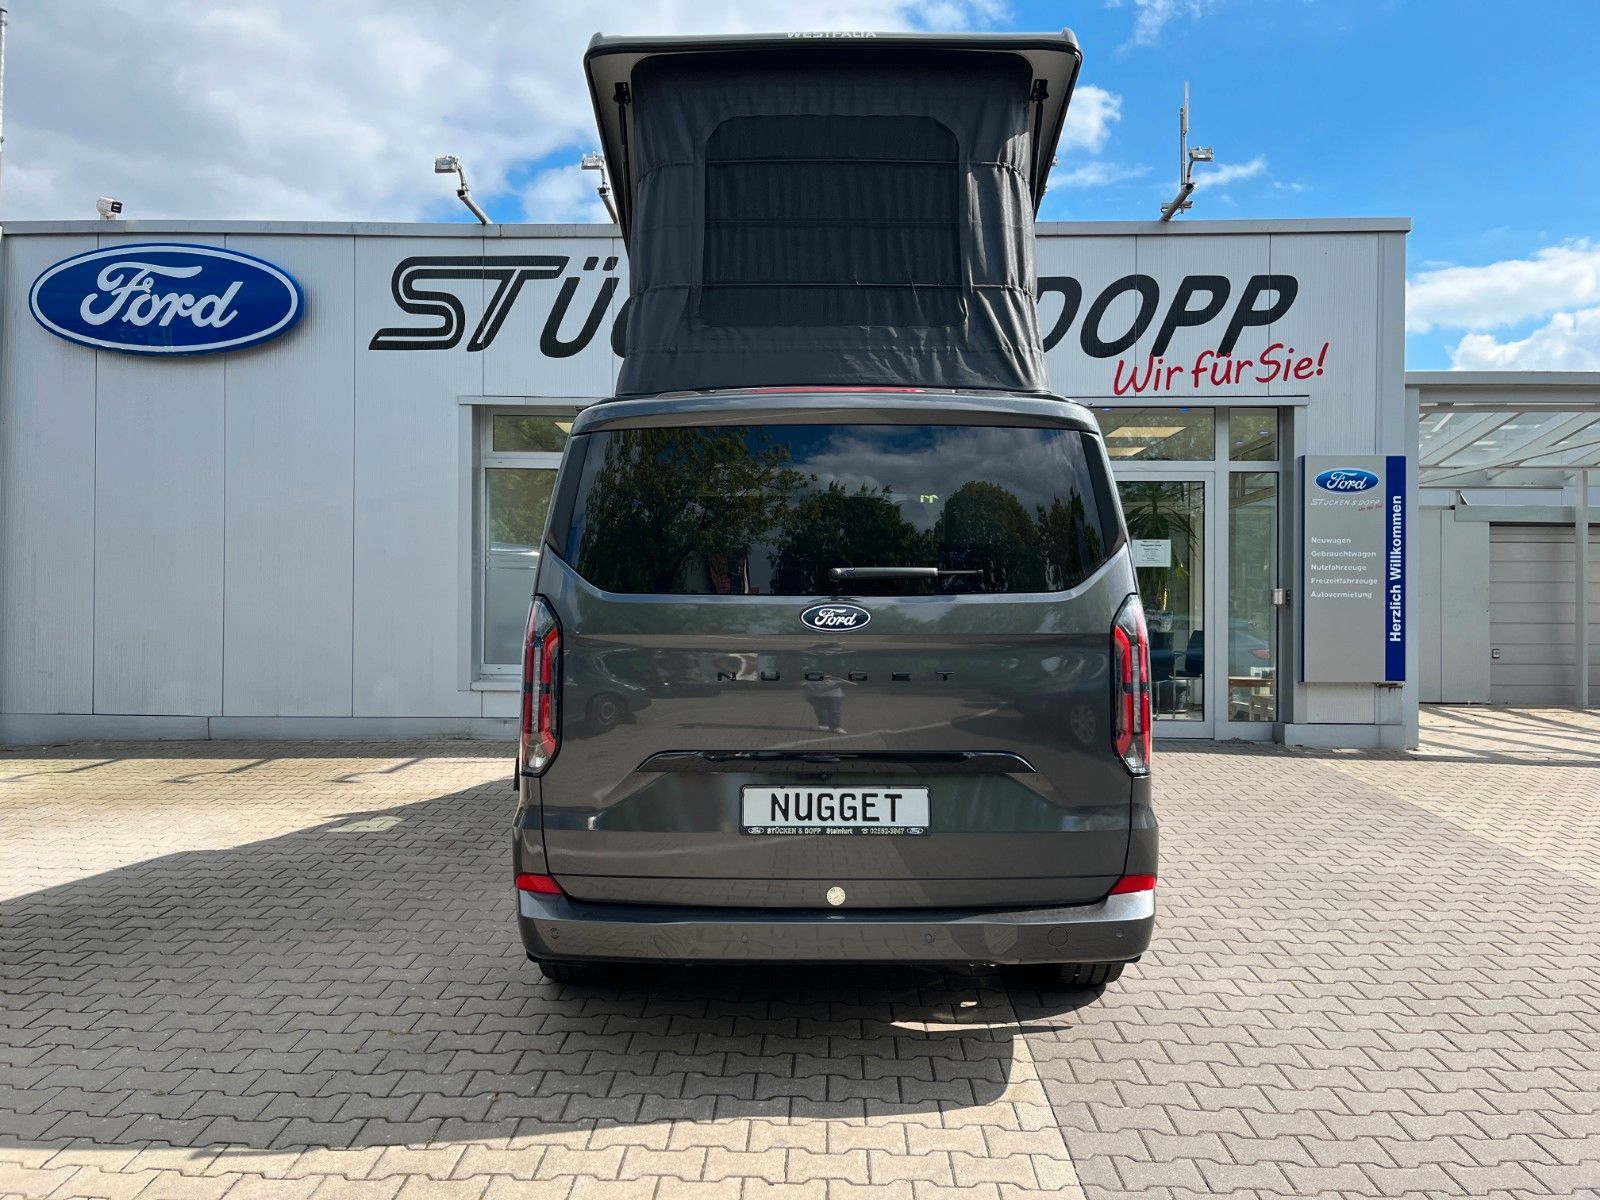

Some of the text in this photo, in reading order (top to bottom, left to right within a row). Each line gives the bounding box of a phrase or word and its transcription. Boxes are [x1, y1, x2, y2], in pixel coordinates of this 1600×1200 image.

[79, 261, 244, 329] Ford
[368, 255, 629, 359] STÜ
[1113, 342, 1330, 396] Wir für Sie!
[1326, 471, 1368, 490] Ford
[1311, 537, 1352, 545] Neuwagen
[1310, 550, 1377, 559] Gebrauchtwagen
[1310, 564, 1367, 572] Nutzfahrzeuge
[1389, 495, 1402, 642] Herzlich Willkommen
[1310, 577, 1378, 586] Freizeitfahrzeuge
[1310, 591, 1373, 600] Autovermietung
[814, 608, 857, 626] Ford
[717, 671, 955, 682] NUGGET
[770, 793, 903, 823] NUGGET
[804, 827, 822, 835] DOPP
